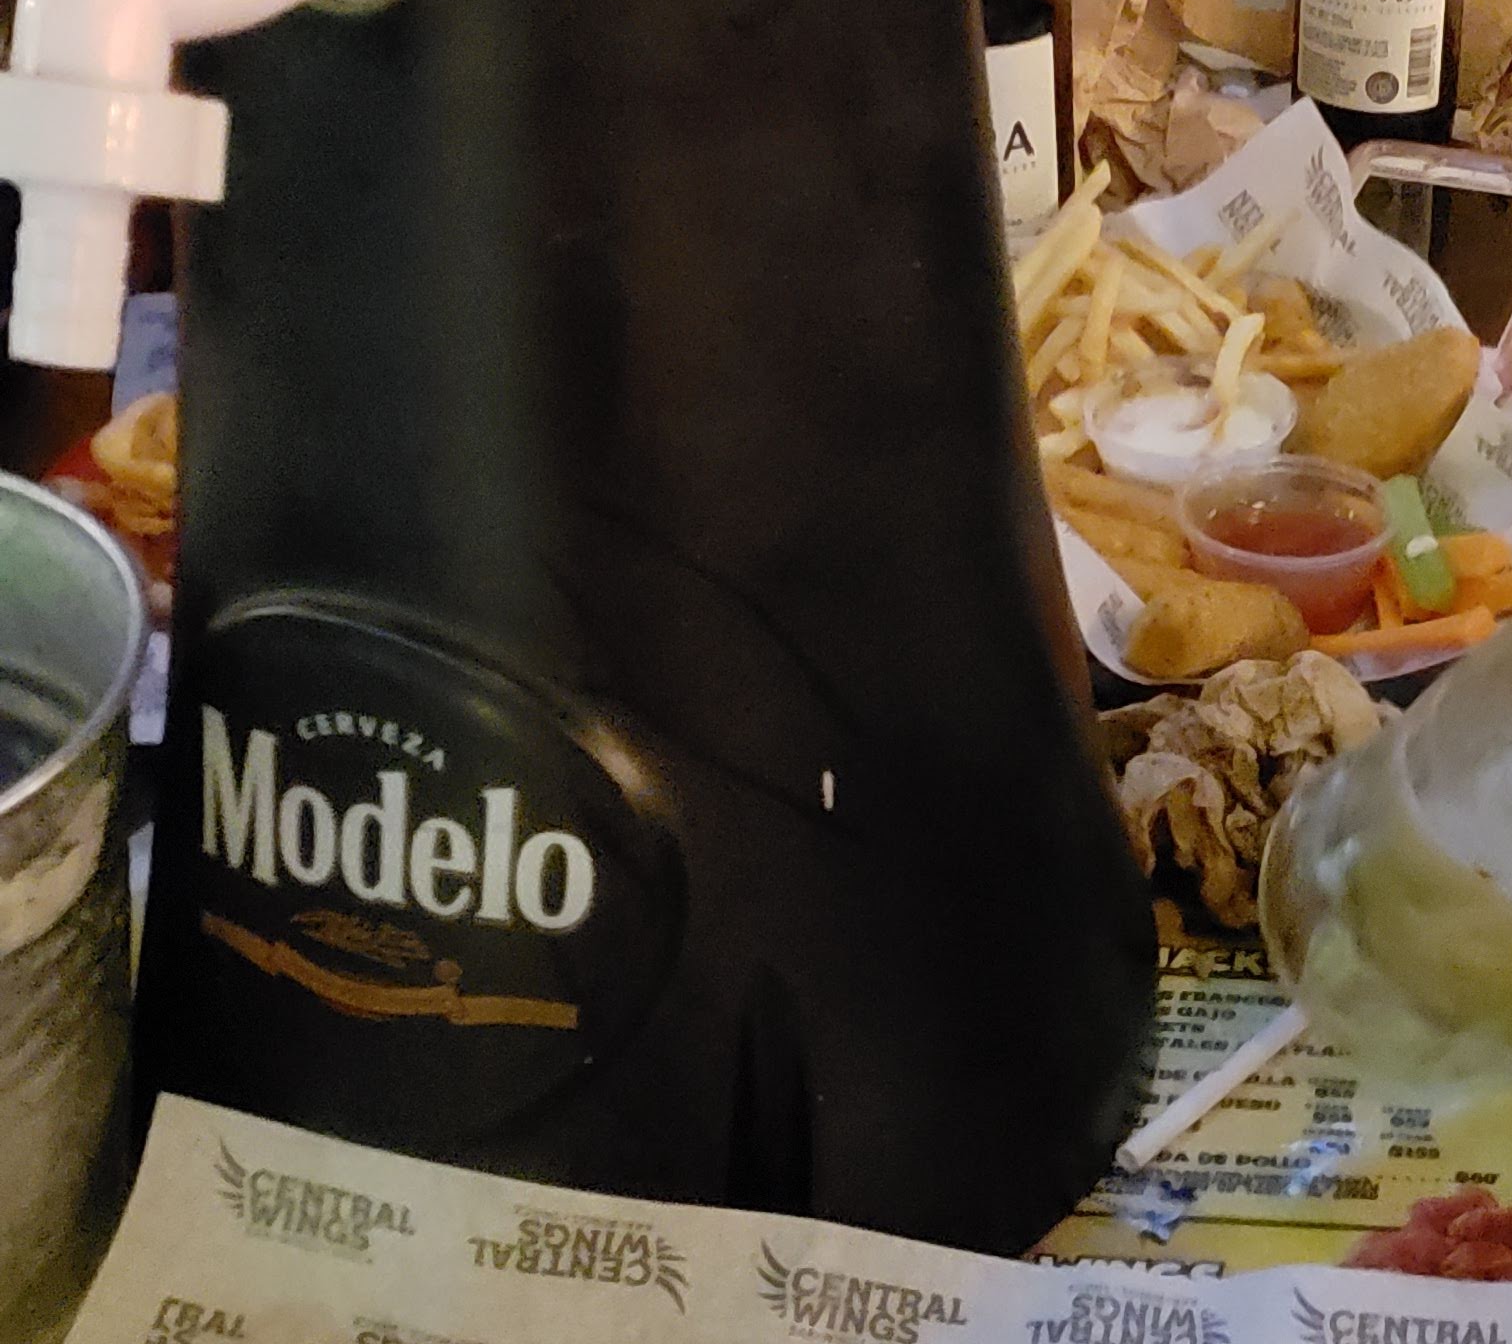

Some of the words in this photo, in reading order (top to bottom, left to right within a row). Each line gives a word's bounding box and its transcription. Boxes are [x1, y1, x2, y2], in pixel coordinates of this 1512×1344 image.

[297, 712, 447, 770] CERVEZA
[202, 703, 595, 932] Modelo
[249, 1167, 414, 1235] CENTRAL
[469, 1236, 653, 1286] CENTRAL
[519, 1217, 654, 1258] WINGS
[792, 1267, 967, 1325] CENTRAL
[1072, 1293, 1198, 1334] WINGS
